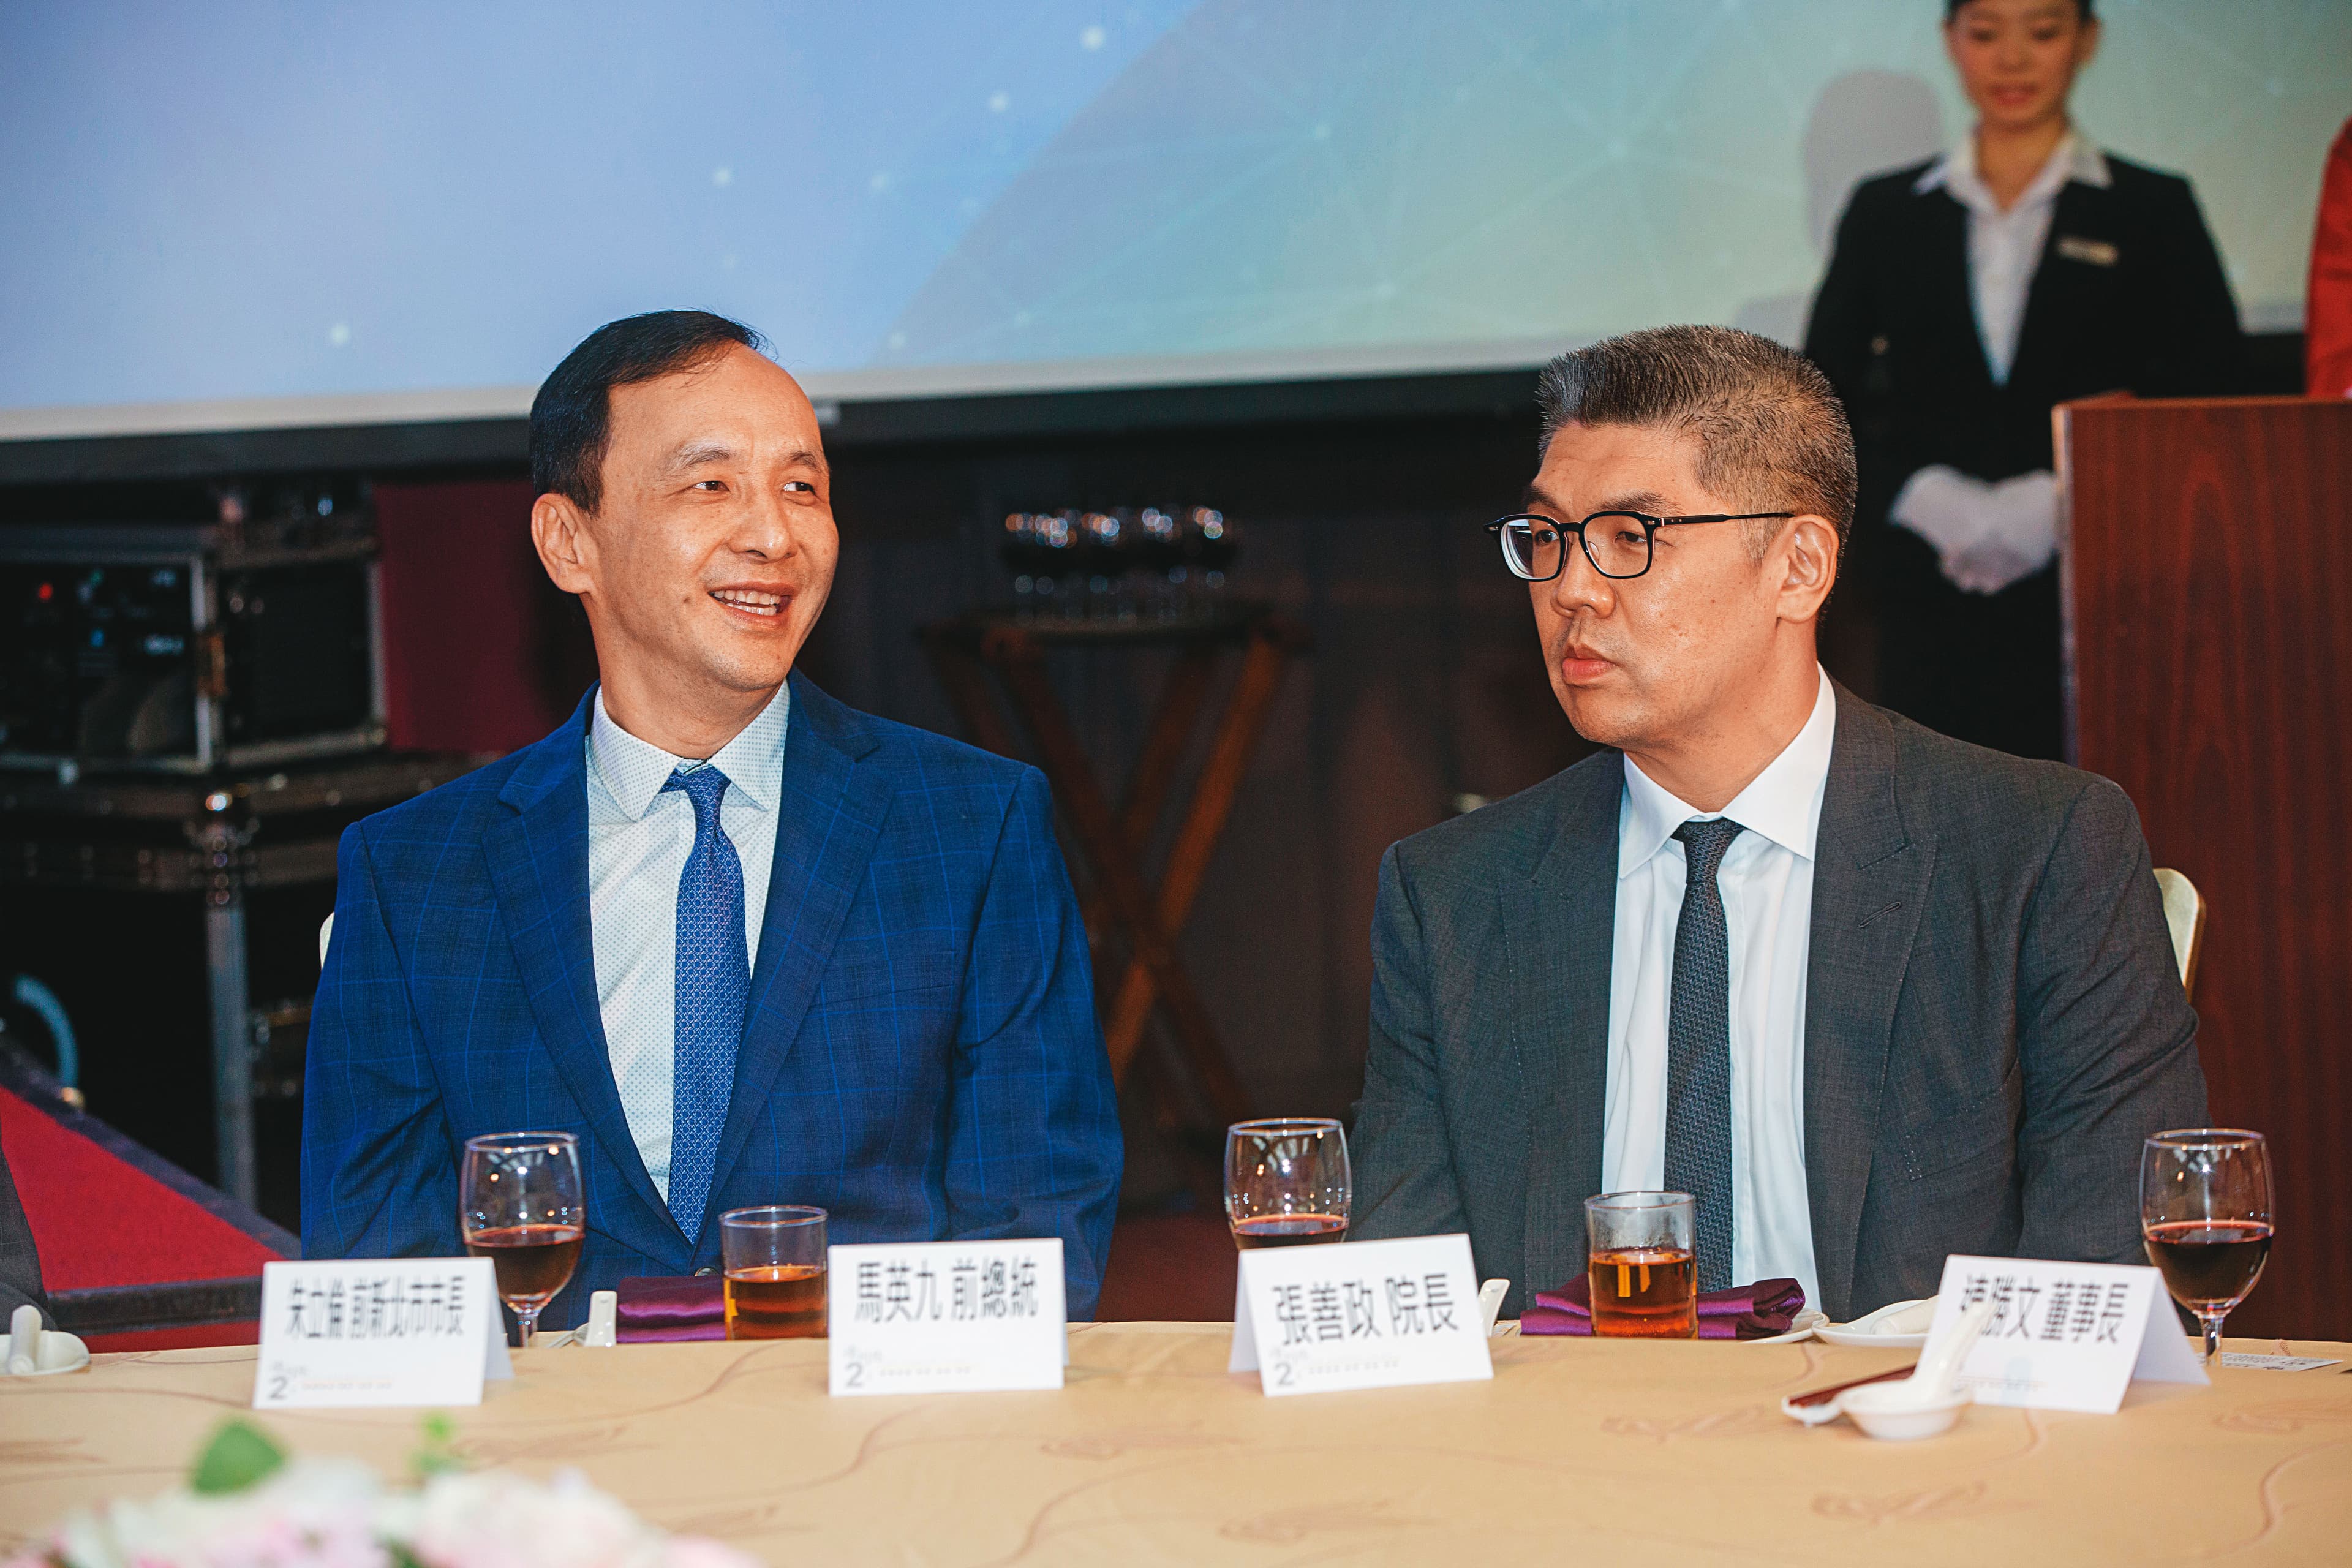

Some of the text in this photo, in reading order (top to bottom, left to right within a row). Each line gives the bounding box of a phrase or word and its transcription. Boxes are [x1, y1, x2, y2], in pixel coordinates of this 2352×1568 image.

[855, 1257, 1039, 1323] 馬英九 前總統
[1272, 1272, 1460, 1346] 張善政 院長
[2040, 1280, 2131, 1344] 董事長
